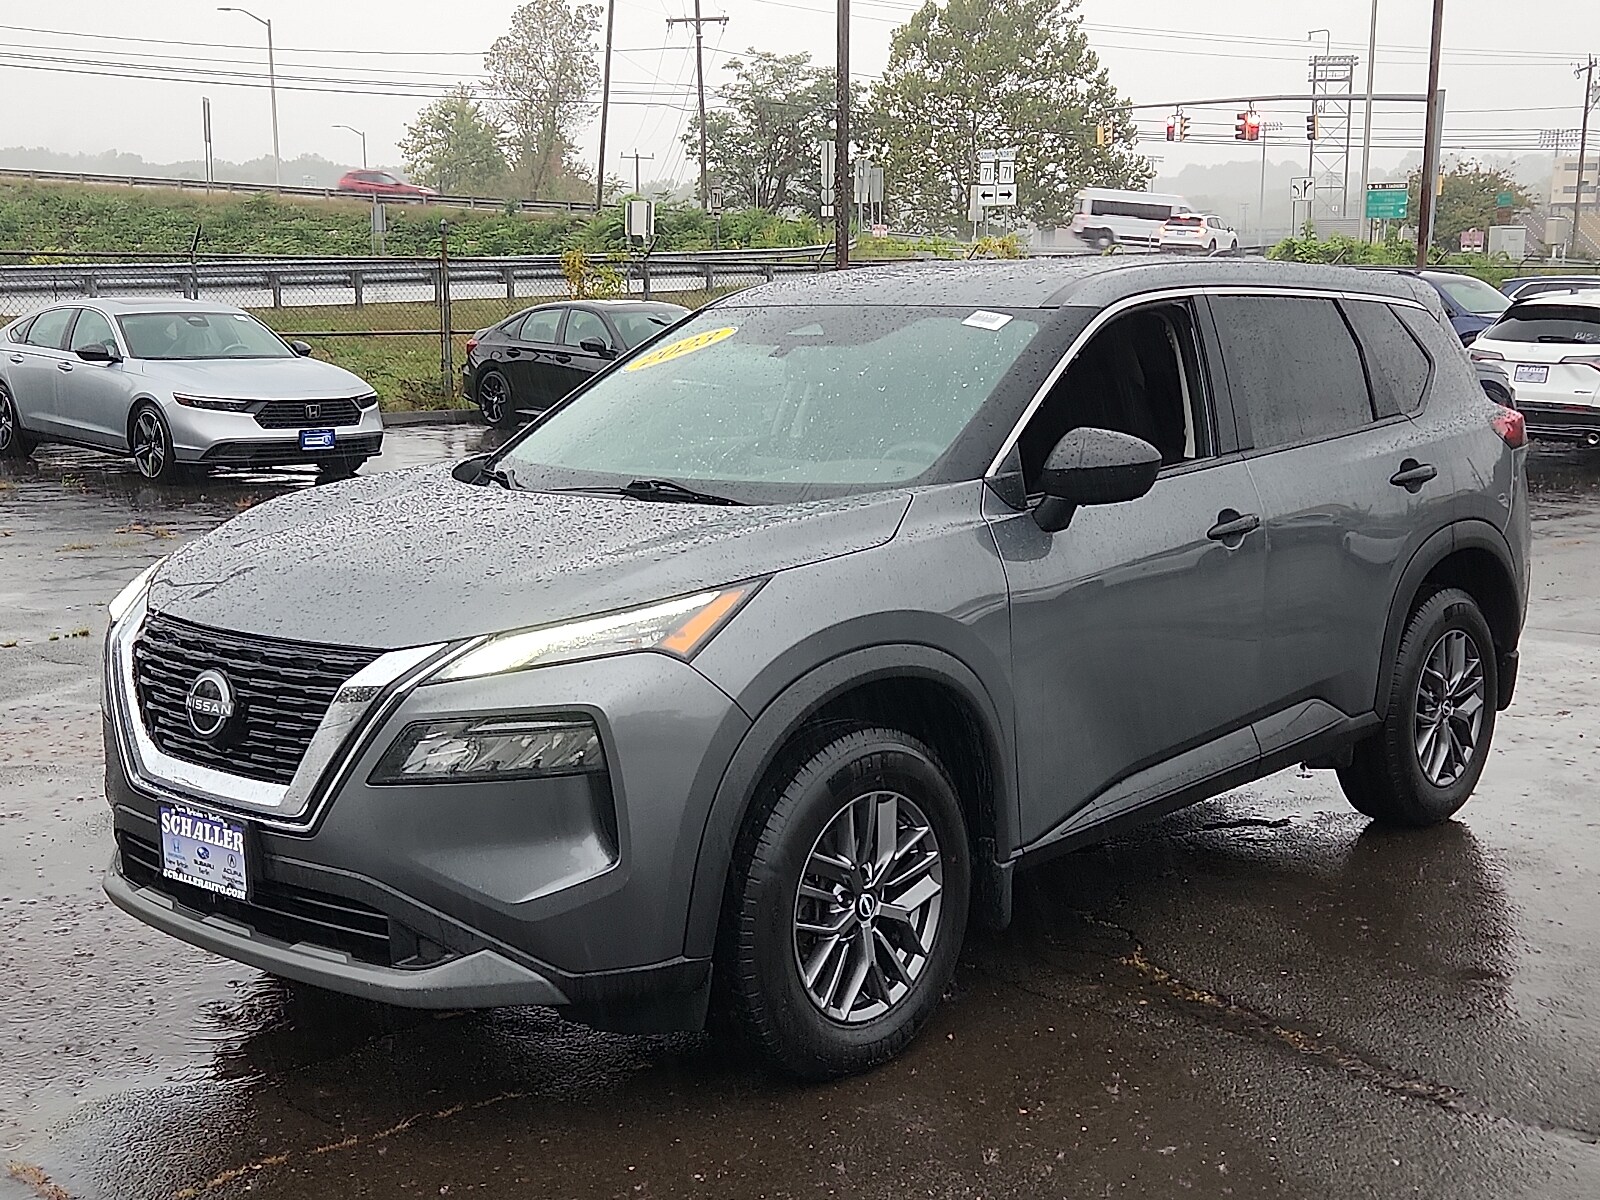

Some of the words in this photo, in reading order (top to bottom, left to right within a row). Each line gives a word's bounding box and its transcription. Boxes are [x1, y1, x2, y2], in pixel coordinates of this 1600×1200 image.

[983, 167, 992, 180] 71
[1002, 166, 1012, 179] 71
[187, 696, 231, 715] NISSAN
[161, 812, 244, 855] SCHALLER
[162, 868, 246, 900] SCHALLERAUTO.COM
